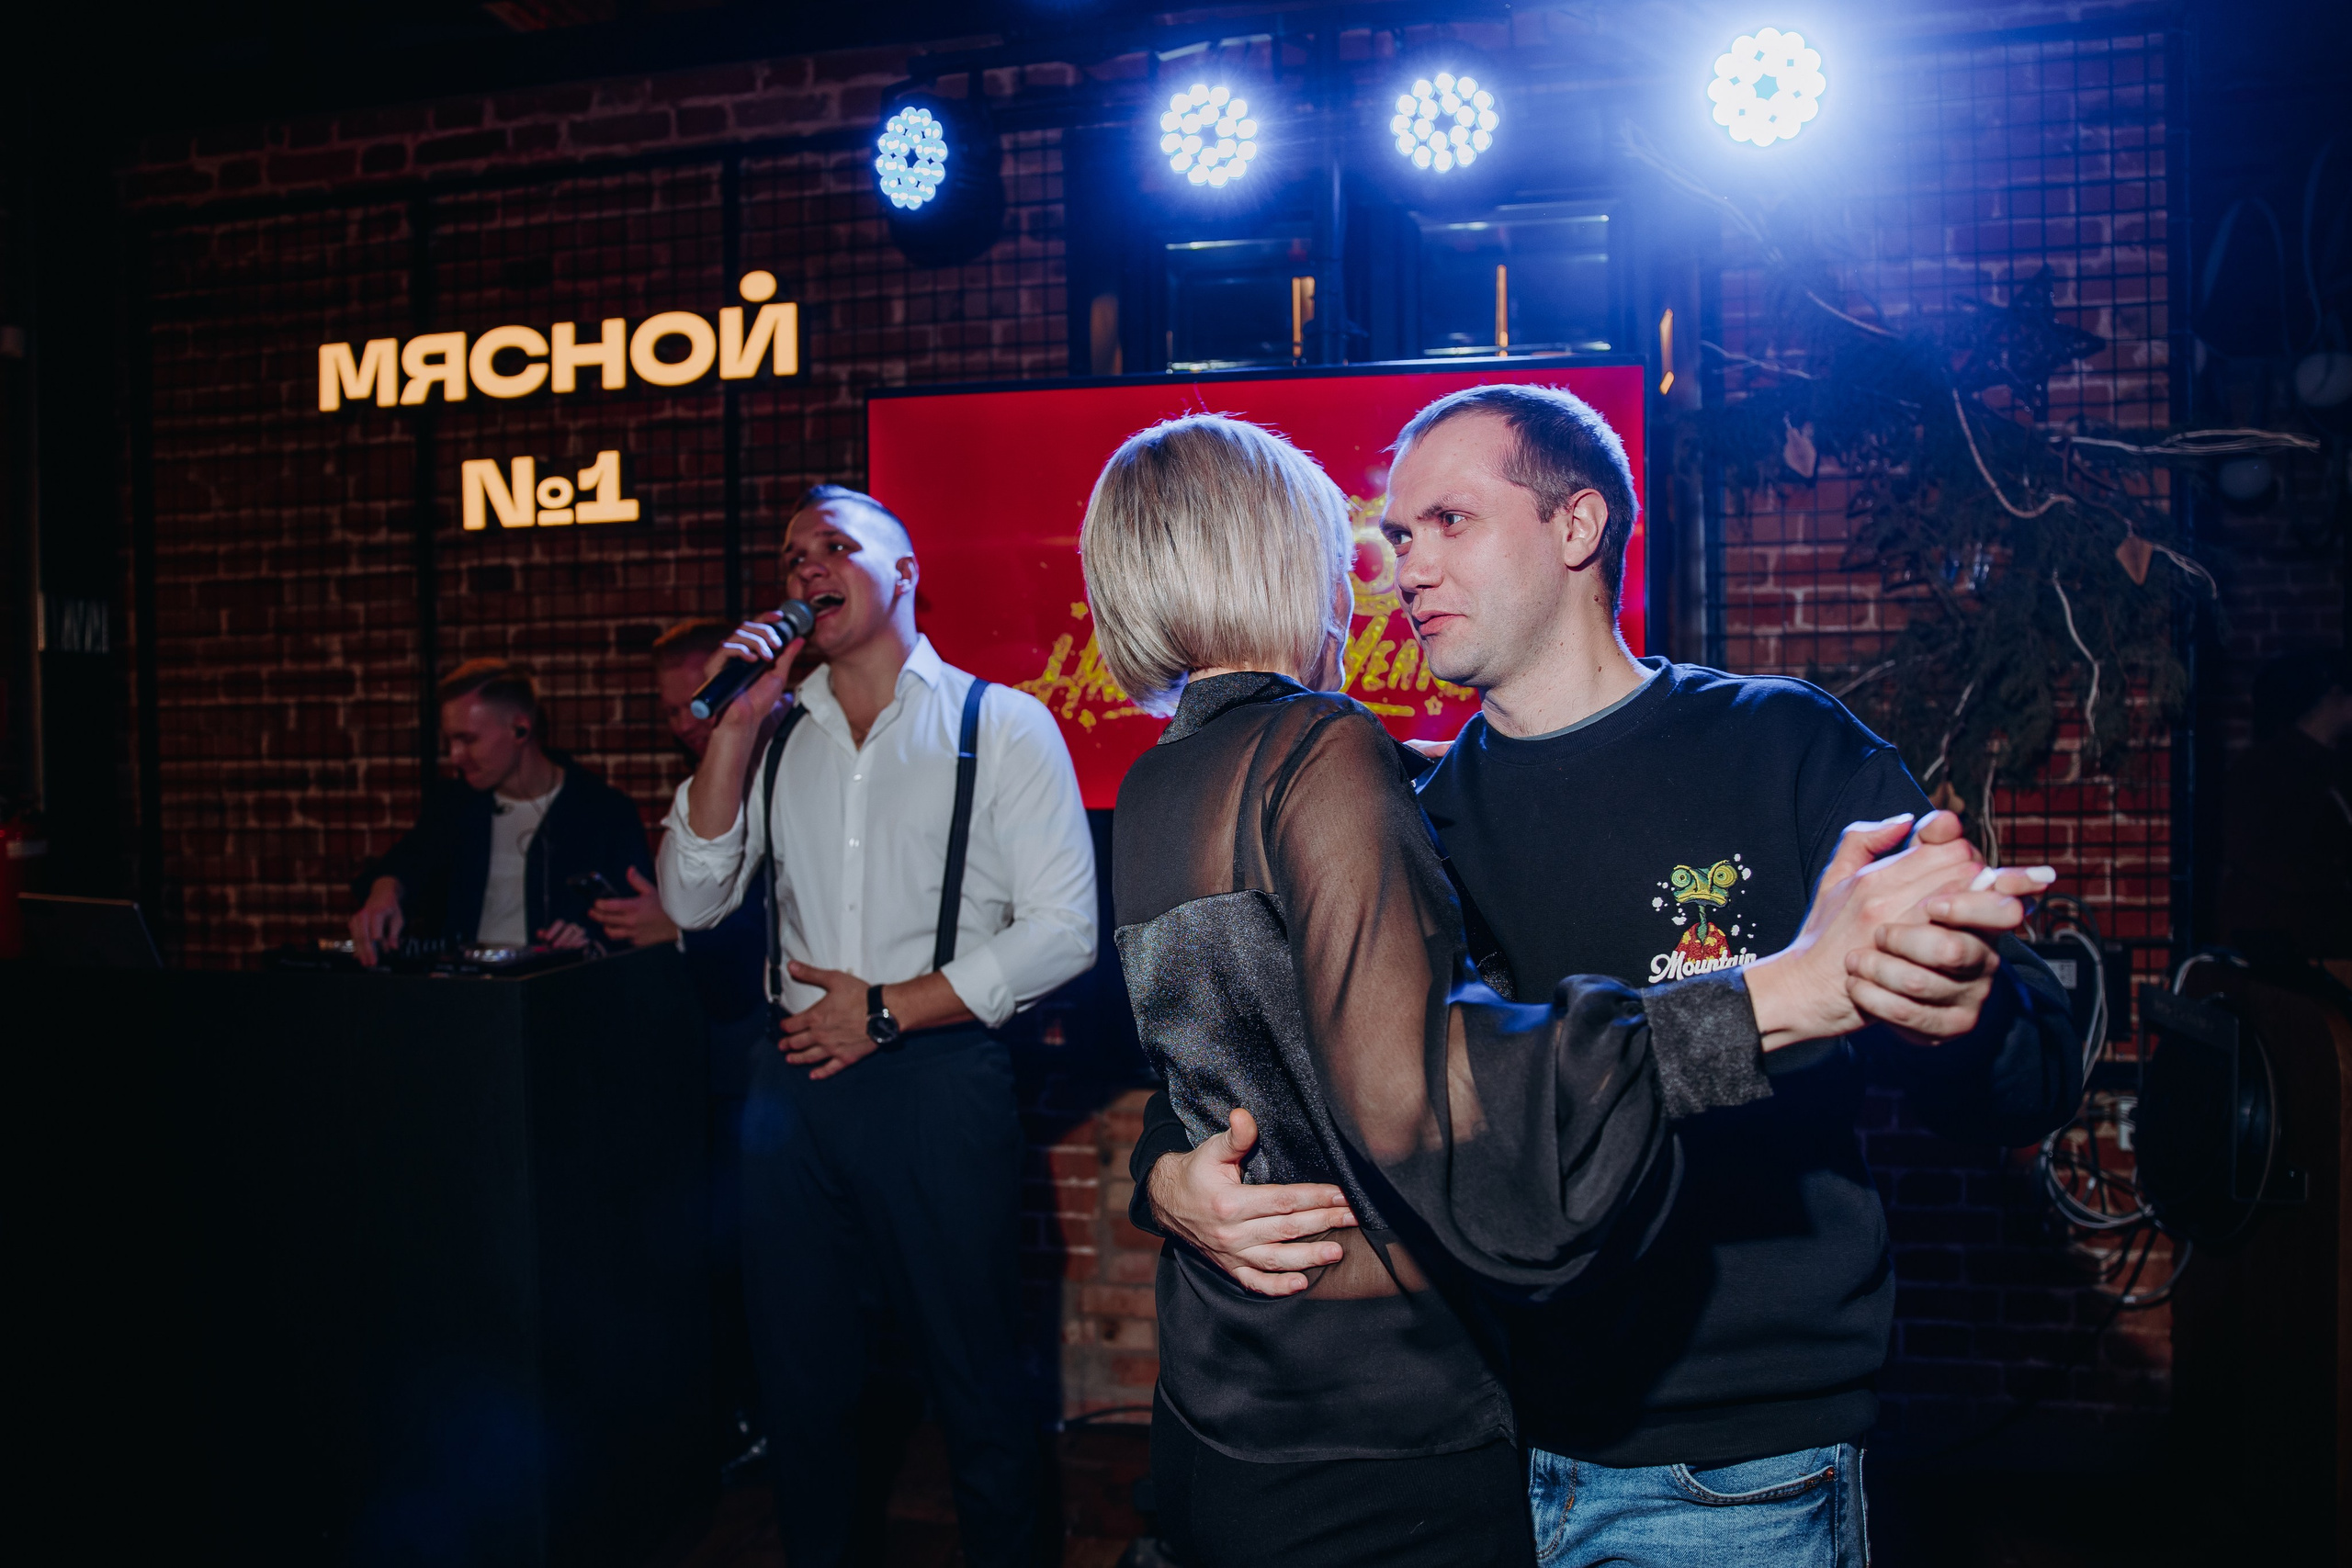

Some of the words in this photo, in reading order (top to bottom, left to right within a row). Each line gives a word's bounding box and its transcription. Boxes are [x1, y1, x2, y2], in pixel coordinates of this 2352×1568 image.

[318, 269, 797, 412] МЯСНОЙ
[461, 449, 640, 531] №1
[1648, 947, 1757, 983] Mountain
